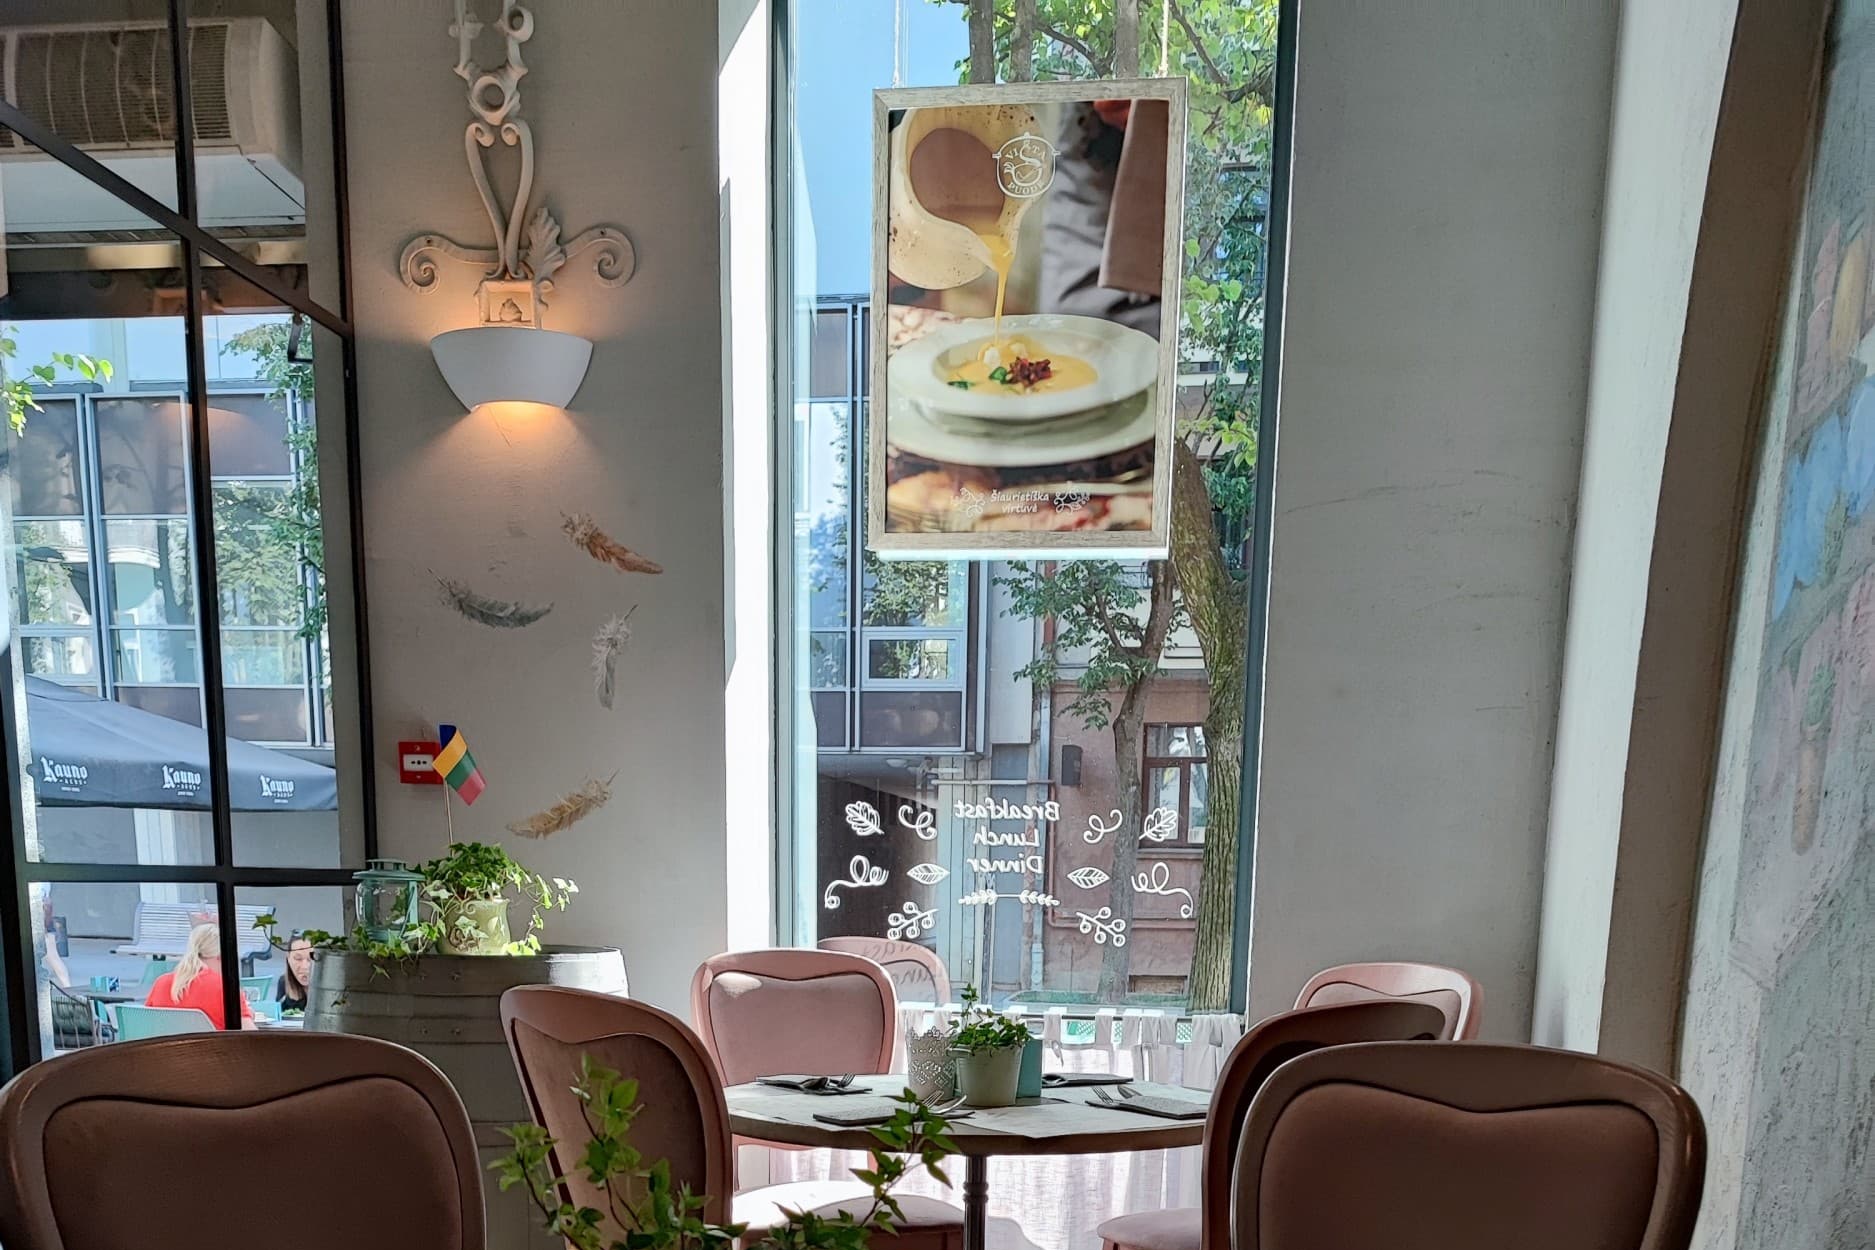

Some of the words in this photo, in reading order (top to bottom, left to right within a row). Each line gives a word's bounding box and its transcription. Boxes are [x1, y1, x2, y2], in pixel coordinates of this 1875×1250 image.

[41, 756, 88, 782] Kauno
[162, 765, 201, 789] Kauno
[260, 775, 294, 797] Kauno
